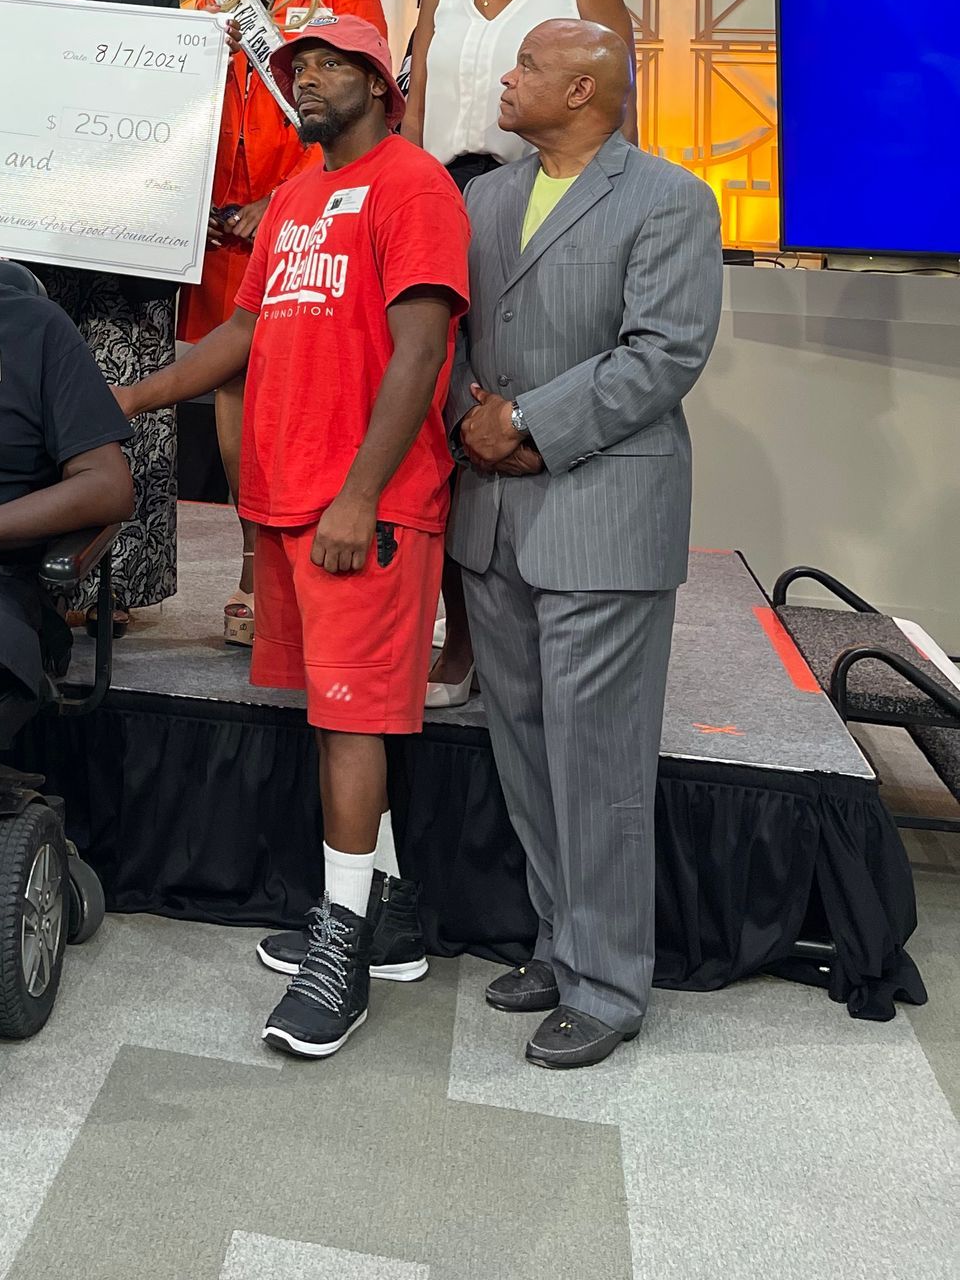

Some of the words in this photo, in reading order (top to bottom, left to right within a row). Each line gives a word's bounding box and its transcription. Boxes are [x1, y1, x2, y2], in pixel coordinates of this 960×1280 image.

[177, 33, 207, 47] 1001
[247, 26, 272, 63] Texas
[95, 41, 187, 72] 8/7/2024
[46, 114, 57, 130] $
[74, 112, 171, 144] 25,000
[5, 150, 54, 171] and
[68, 220, 109, 236] Good
[264, 306, 334, 320] FUNDTION
